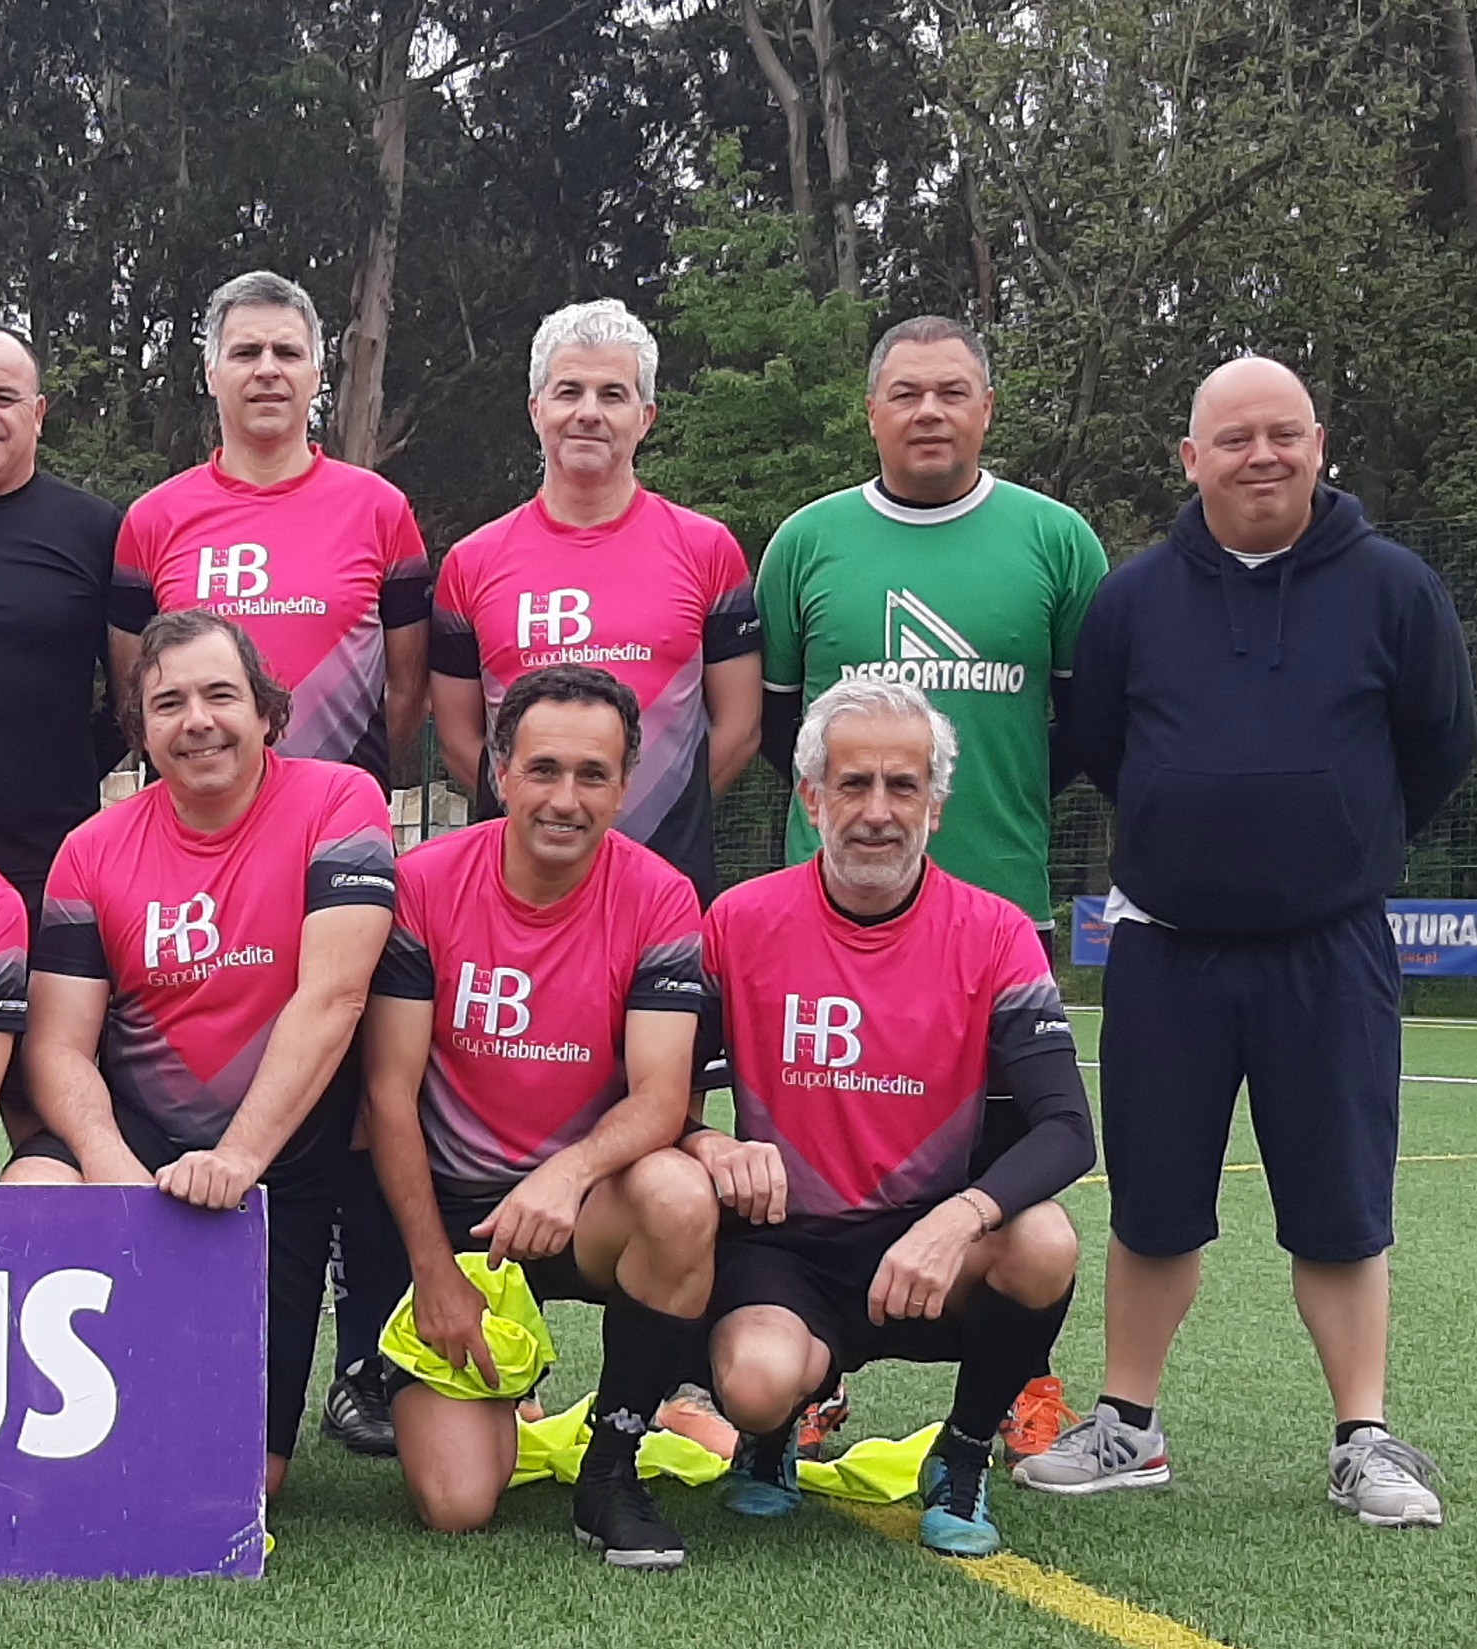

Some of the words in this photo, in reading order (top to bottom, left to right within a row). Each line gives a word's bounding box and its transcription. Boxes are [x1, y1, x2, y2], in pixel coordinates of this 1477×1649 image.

[197, 543, 269, 599] HB
[517, 588, 592, 649] HB
[145, 891, 220, 968] HB
[453, 961, 532, 1037] HB
[782, 994, 862, 1068] HB
